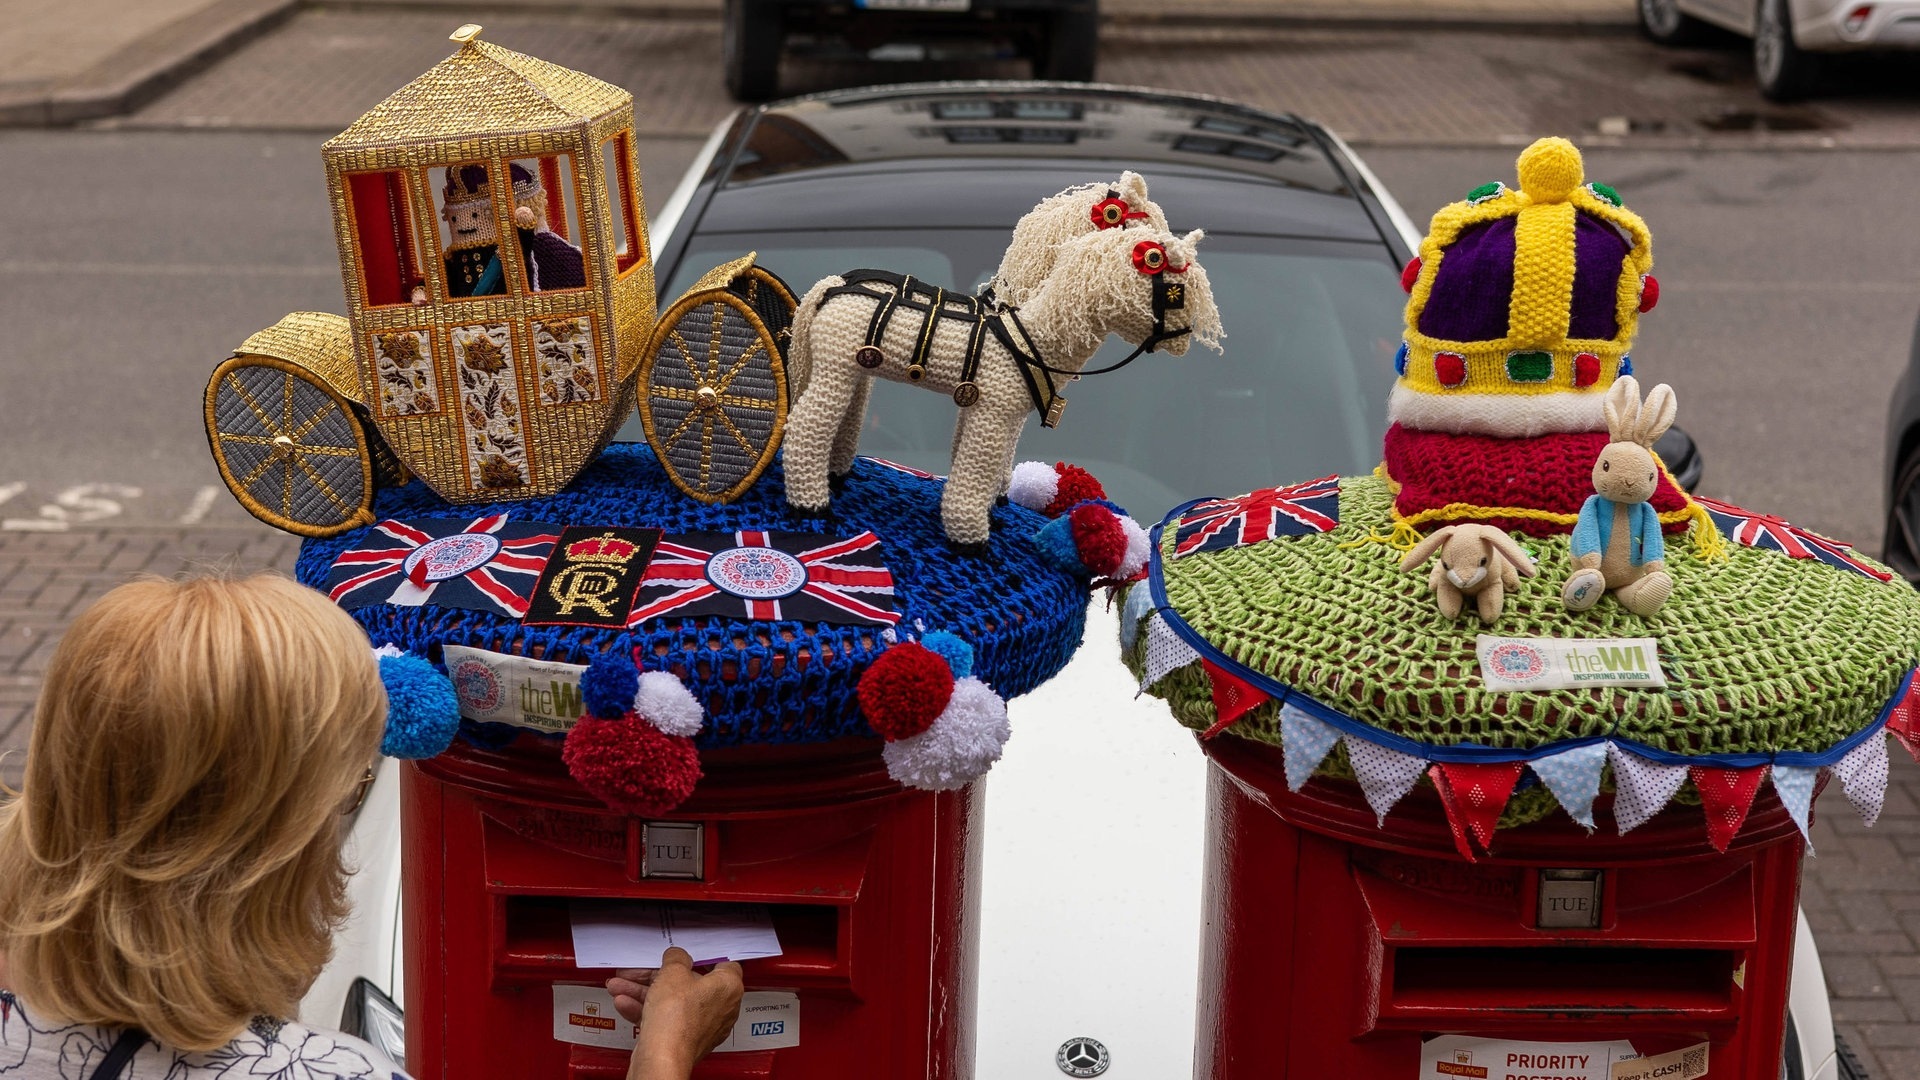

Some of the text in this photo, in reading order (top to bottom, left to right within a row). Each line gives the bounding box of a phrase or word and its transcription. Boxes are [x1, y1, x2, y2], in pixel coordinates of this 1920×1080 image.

[716, 551, 735, 562] KING
[735, 548, 783, 559] CHARLES
[712, 566, 758, 595] CORONATION
[520, 677, 582, 718] theW
[523, 714, 562, 729] INSPIRING
[653, 844, 693, 860] TUE
[1549, 897, 1589, 912] TUE
[745, 1004, 779, 1013] SUPPORTING
[571, 1015, 613, 1028] Royal Mail
[752, 1022, 783, 1035] NHS
[1506, 1053, 1590, 1069] PRIORITY
[1440, 1063, 1485, 1076] Royal Mail
[1643, 1071, 1650, 1079] it
[1652, 1062, 1682, 1078] CASH
